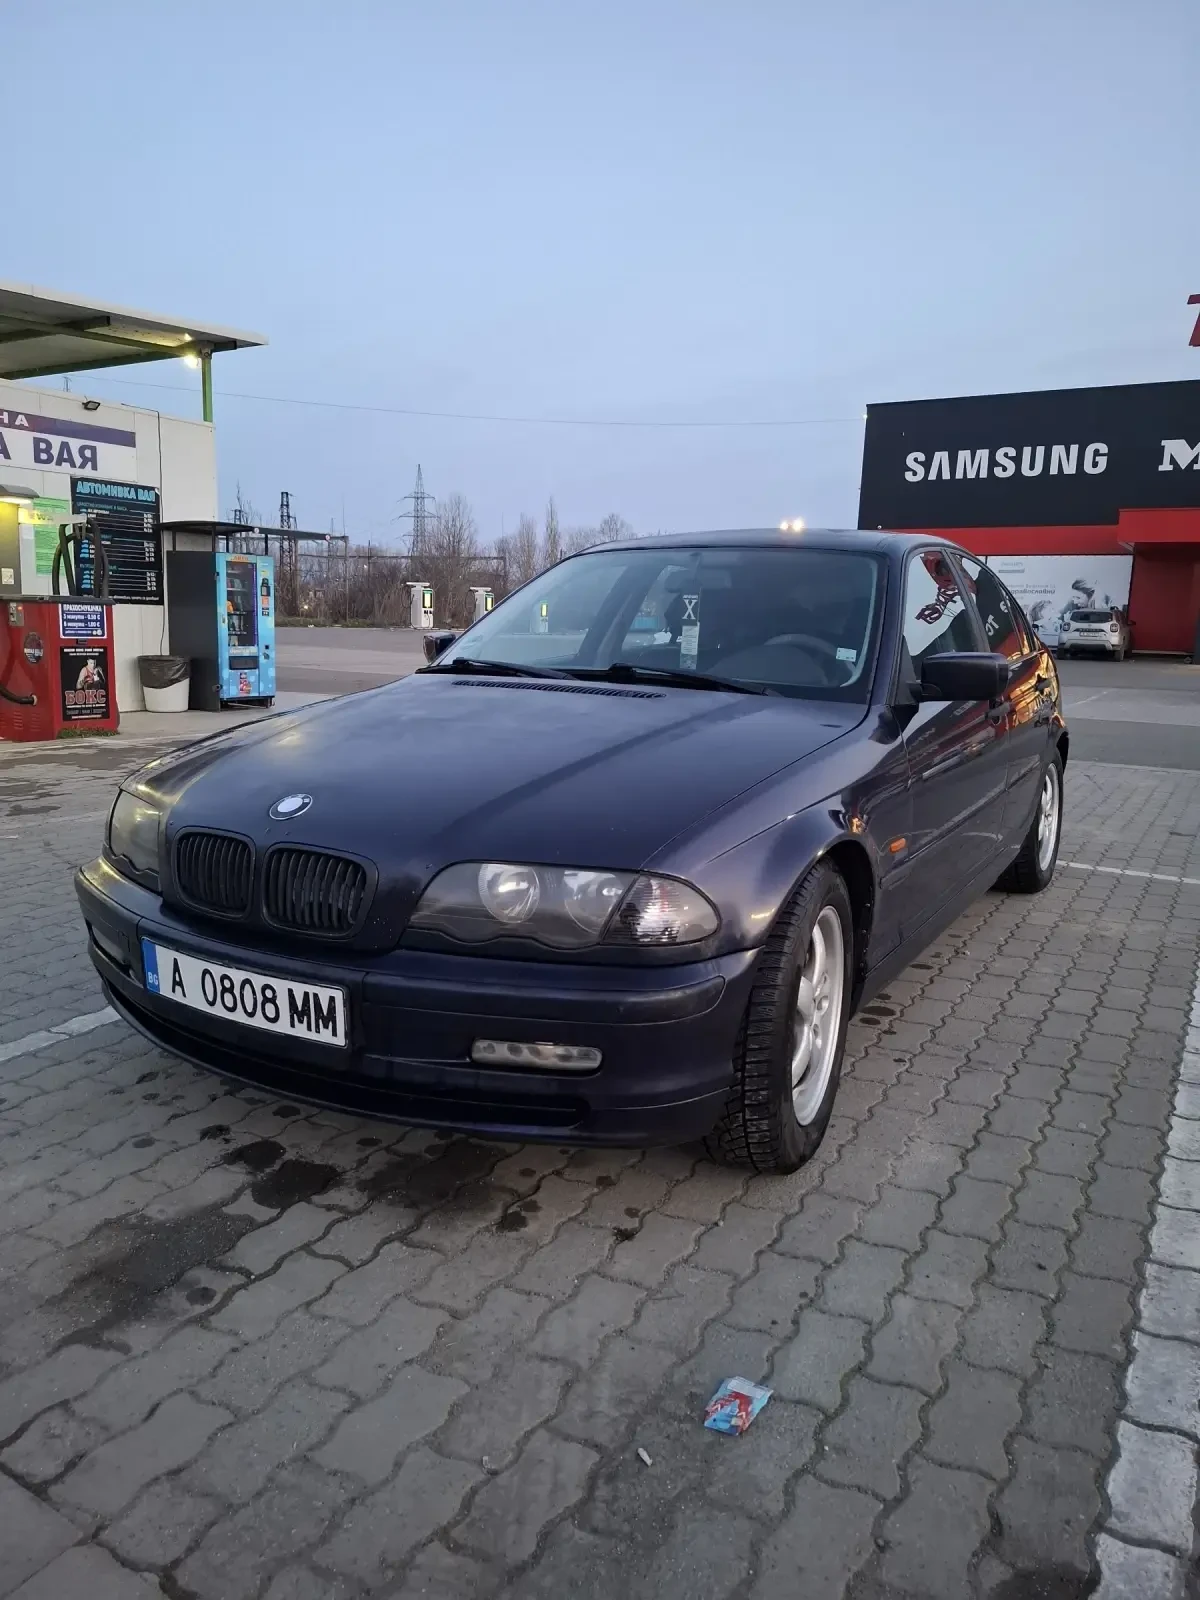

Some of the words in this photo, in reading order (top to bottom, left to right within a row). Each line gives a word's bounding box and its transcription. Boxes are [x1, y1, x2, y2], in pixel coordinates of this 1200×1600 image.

[33, 437, 98, 471] ВАЯ
[904, 442, 1109, 482] SAMSUNG
[76, 481, 136, 499] АВТОМИВКА
[137, 488, 156, 502] ВАЯ
[65, 689, 106, 705] БОКС
[148, 971, 159, 986] BG
[172, 957, 187, 998] A
[201, 968, 280, 1024] 0808
[287, 987, 338, 1038] MM
